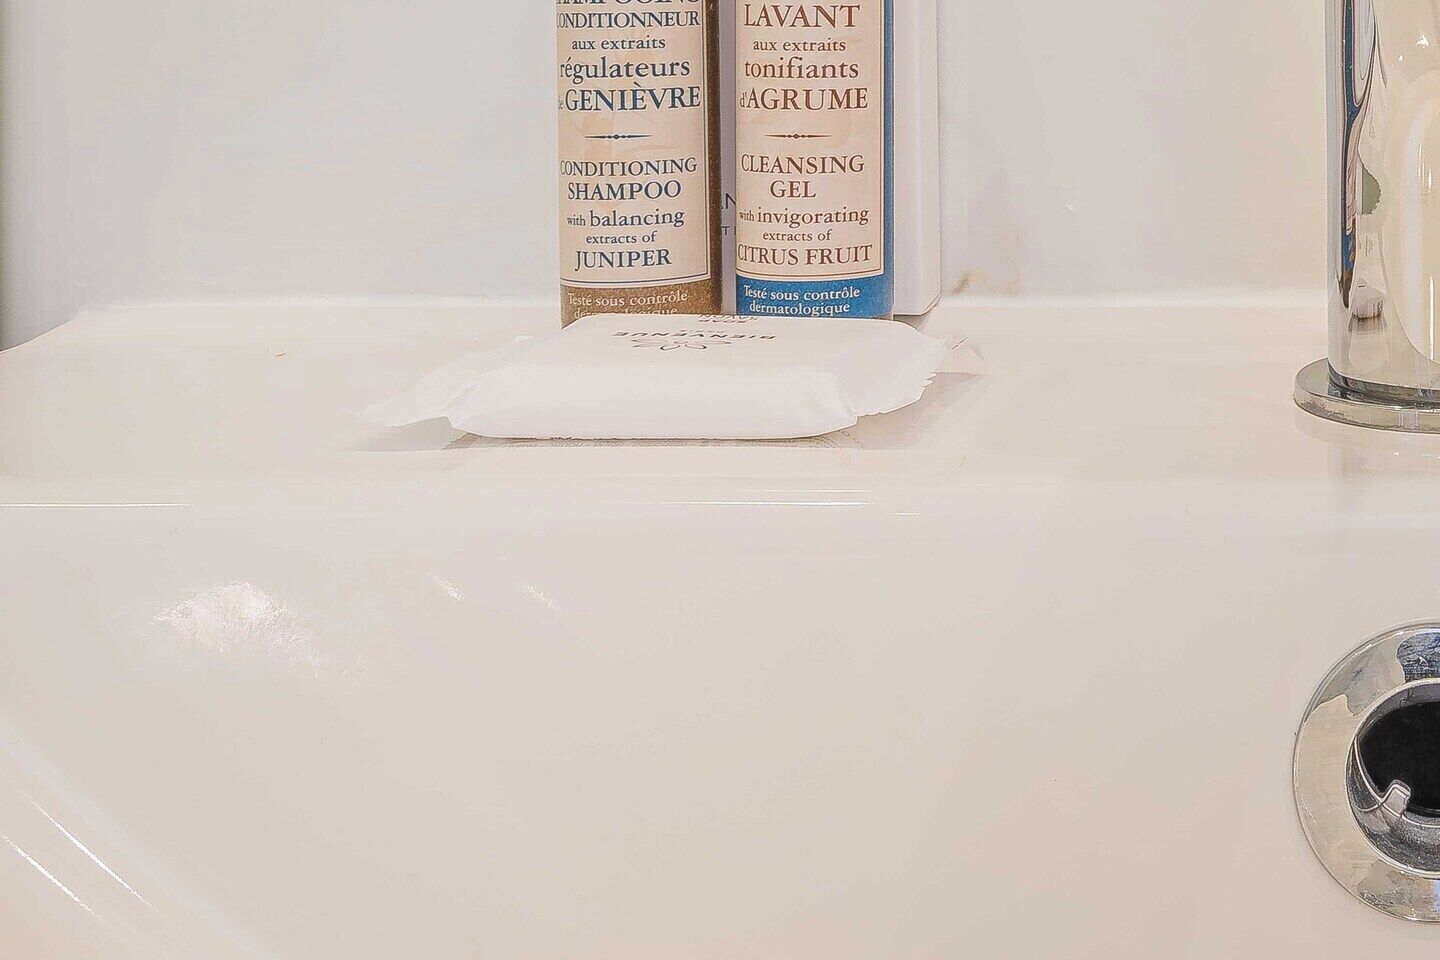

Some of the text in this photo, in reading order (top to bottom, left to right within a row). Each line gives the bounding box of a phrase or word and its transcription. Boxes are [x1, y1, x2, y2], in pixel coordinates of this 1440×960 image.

[744, 3, 861, 28] LAVANT
[572, 34, 666, 51] aux extraits
[753, 37, 846, 52] aux extraits
[560, 56, 691, 85] régulateurs
[744, 56, 860, 79] tonifiants
[565, 81, 701, 112] GENIÈVRE
[560, 157, 698, 177] CONDITIONING
[741, 154, 865, 175] CLEANSING
[567, 180, 682, 201] SHAMPOO
[769, 180, 817, 199] GEL
[567, 208, 685, 227] with balancing
[739, 206, 870, 229] with invigorating
[586, 230, 658, 245] extracts of
[762, 228, 834, 242] extracts of
[575, 248, 672, 272] JUNIPER
[737, 243, 873, 266] CITRUS FRUIT
[568, 290, 689, 307] Testé sous contrôle
[743, 285, 860, 301] Testé sous contrôle
[749, 300, 850, 318] dermatologique
